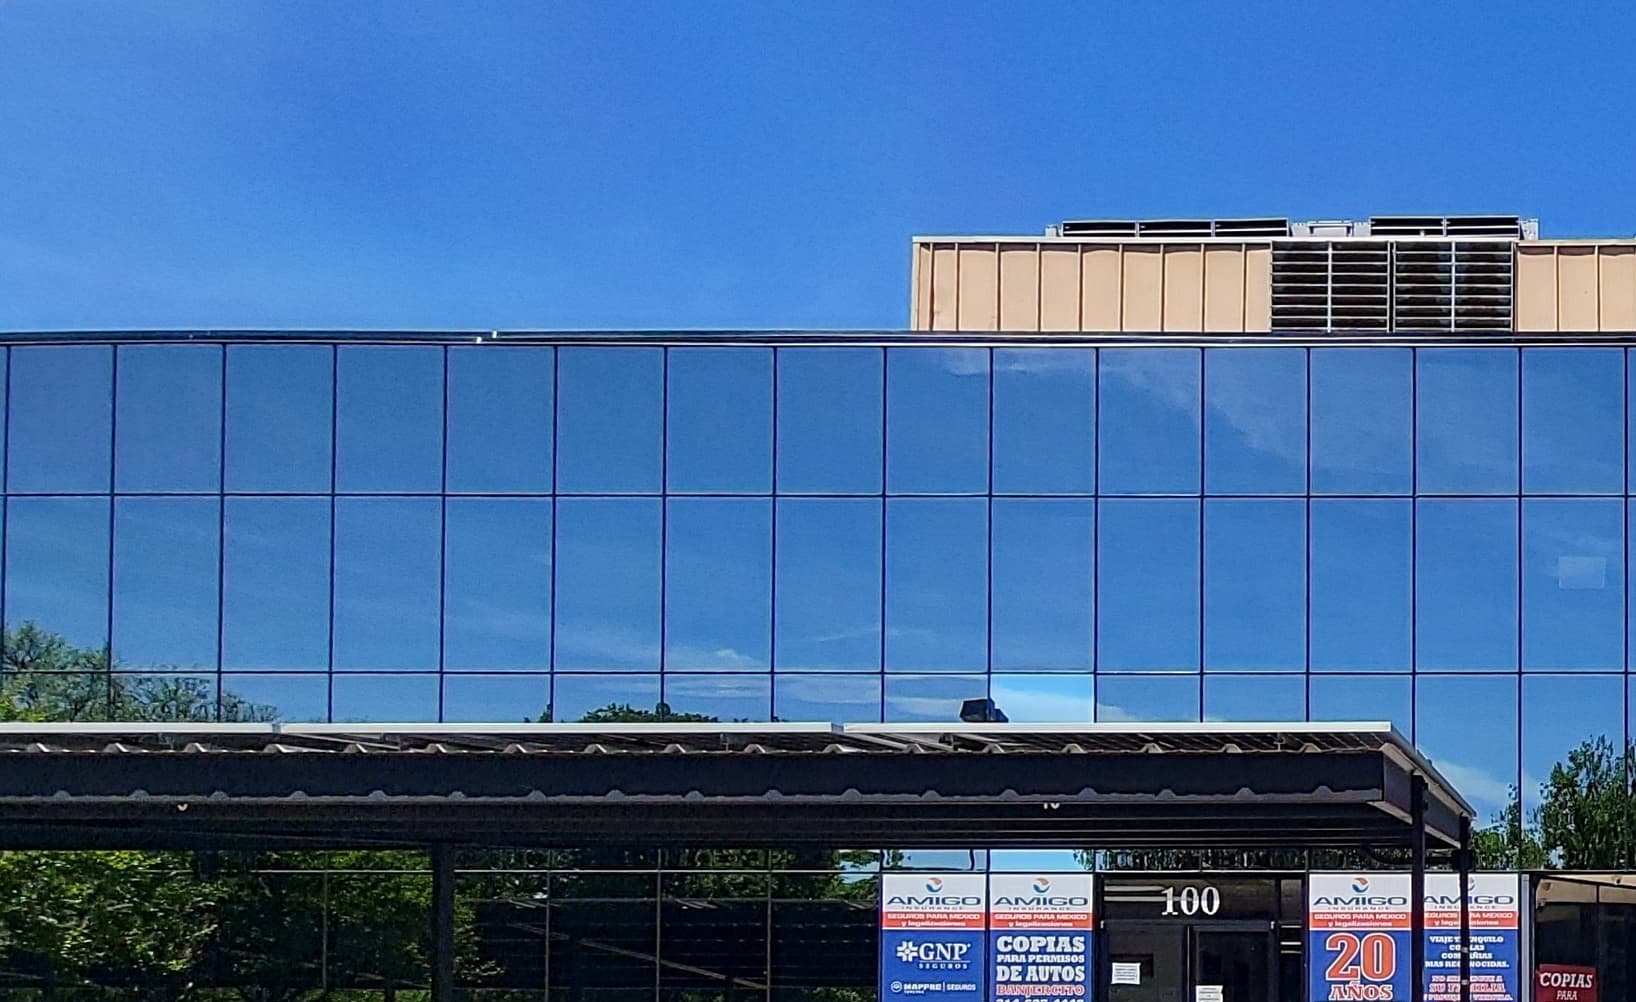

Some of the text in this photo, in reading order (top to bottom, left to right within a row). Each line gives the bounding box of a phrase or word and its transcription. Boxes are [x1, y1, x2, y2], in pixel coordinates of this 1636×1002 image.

[887, 896, 981, 906] AMIGO
[994, 896, 1088, 906] AMIGO
[1161, 886, 1221, 916] 100
[1313, 896, 1407, 906] AMIGO
[1424, 895, 1514, 905] AMIGO
[996, 935, 1086, 953] COPIAS
[1429, 936, 1454, 944] VIAJE
[919, 943, 968, 960] GNP
[996, 954, 1085, 963] PARA PERMISOS
[1325, 932, 1396, 982] 20
[996, 965, 1085, 982] DE AUTOS
[1540, 972, 1593, 988] COPIAS
[996, 984, 1085, 998] BANJERCITO
[1328, 980, 1393, 1001] AÑOS
[1556, 990, 1577, 1000] PARA
